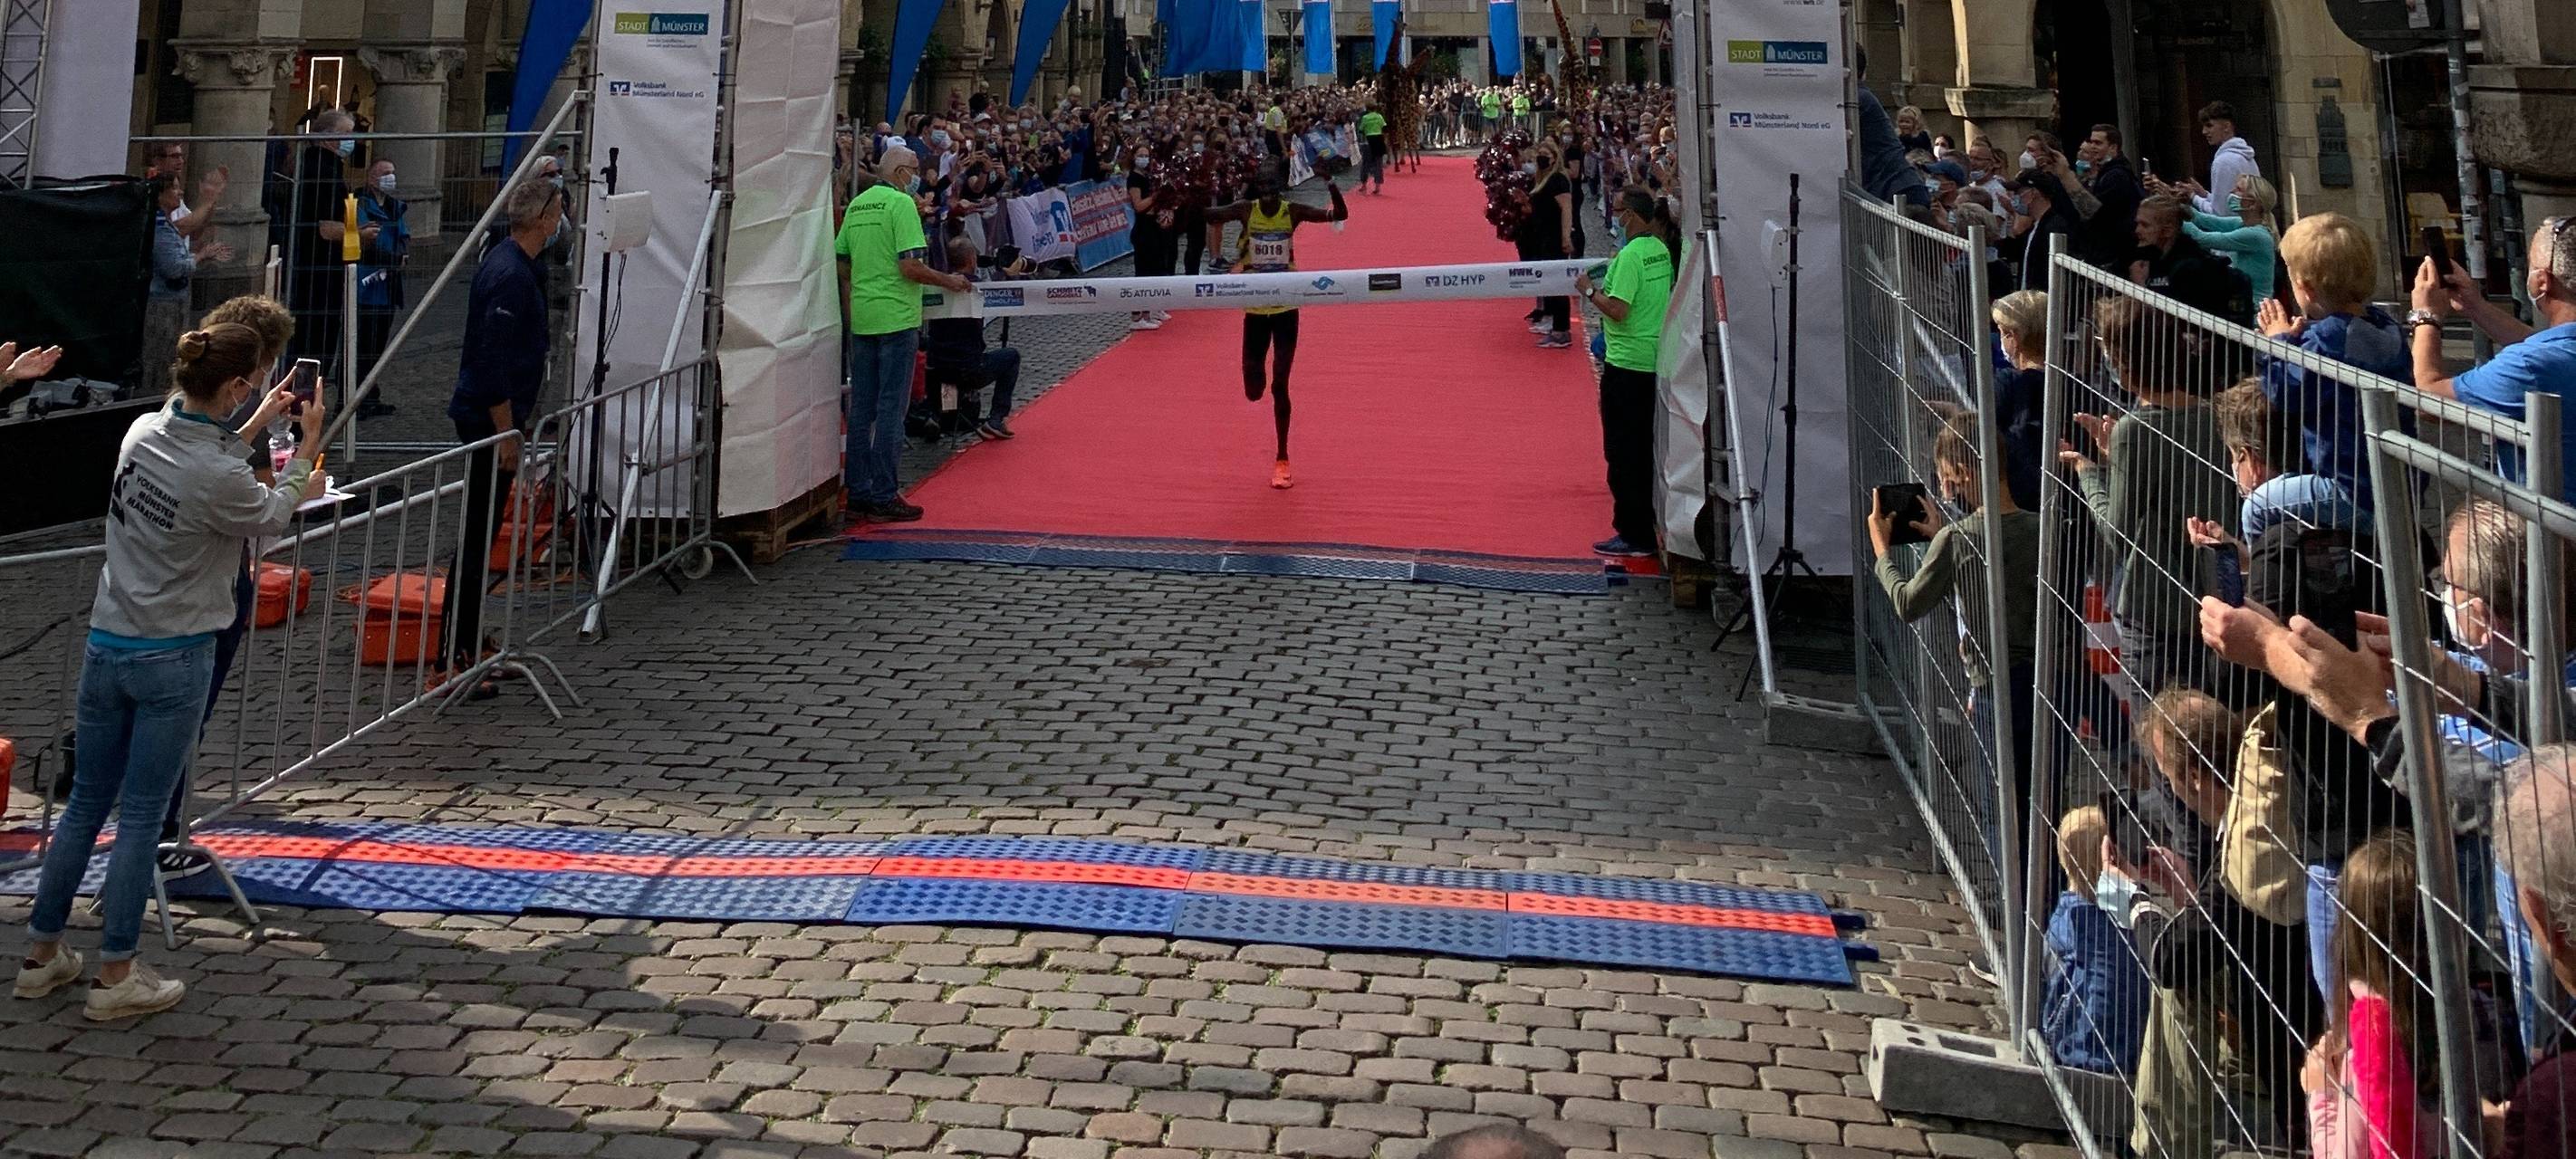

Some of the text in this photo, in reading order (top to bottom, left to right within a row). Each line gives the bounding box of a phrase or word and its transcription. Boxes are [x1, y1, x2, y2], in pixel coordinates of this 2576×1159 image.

[618, 21, 705, 32] STADT MÜNSTER
[1731, 49, 1823, 61] STADT MÜNSTER
[1754, 121, 1800, 129] Münsterland
[1443, 273, 1485, 287] DZ HYP
[138, 474, 180, 509] VOLKSBANK
[138, 491, 175, 519] MÜNSTER
[127, 497, 173, 531] MARATHON
